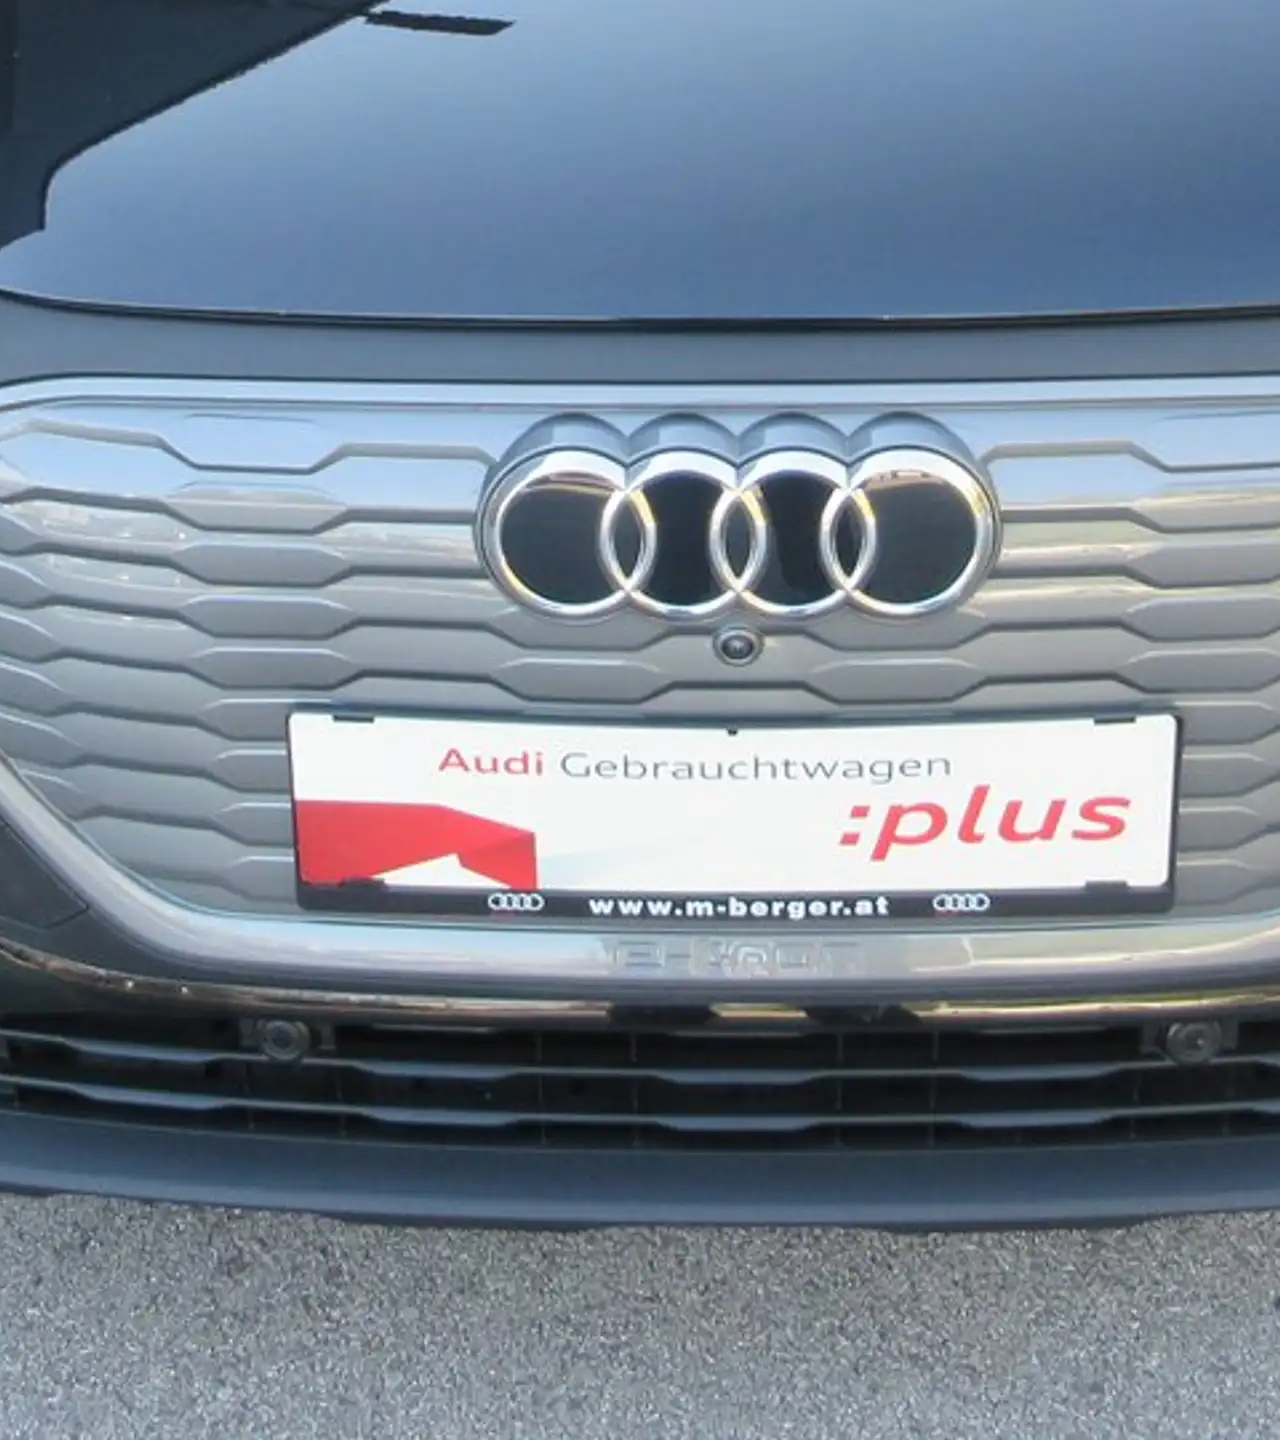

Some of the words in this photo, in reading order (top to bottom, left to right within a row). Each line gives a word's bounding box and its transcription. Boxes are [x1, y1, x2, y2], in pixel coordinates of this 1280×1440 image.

[438, 747, 544, 776] Audi
[560, 752, 952, 785] Gebrauchtwagen
[588, 896, 890, 921] www.m-berger.at
